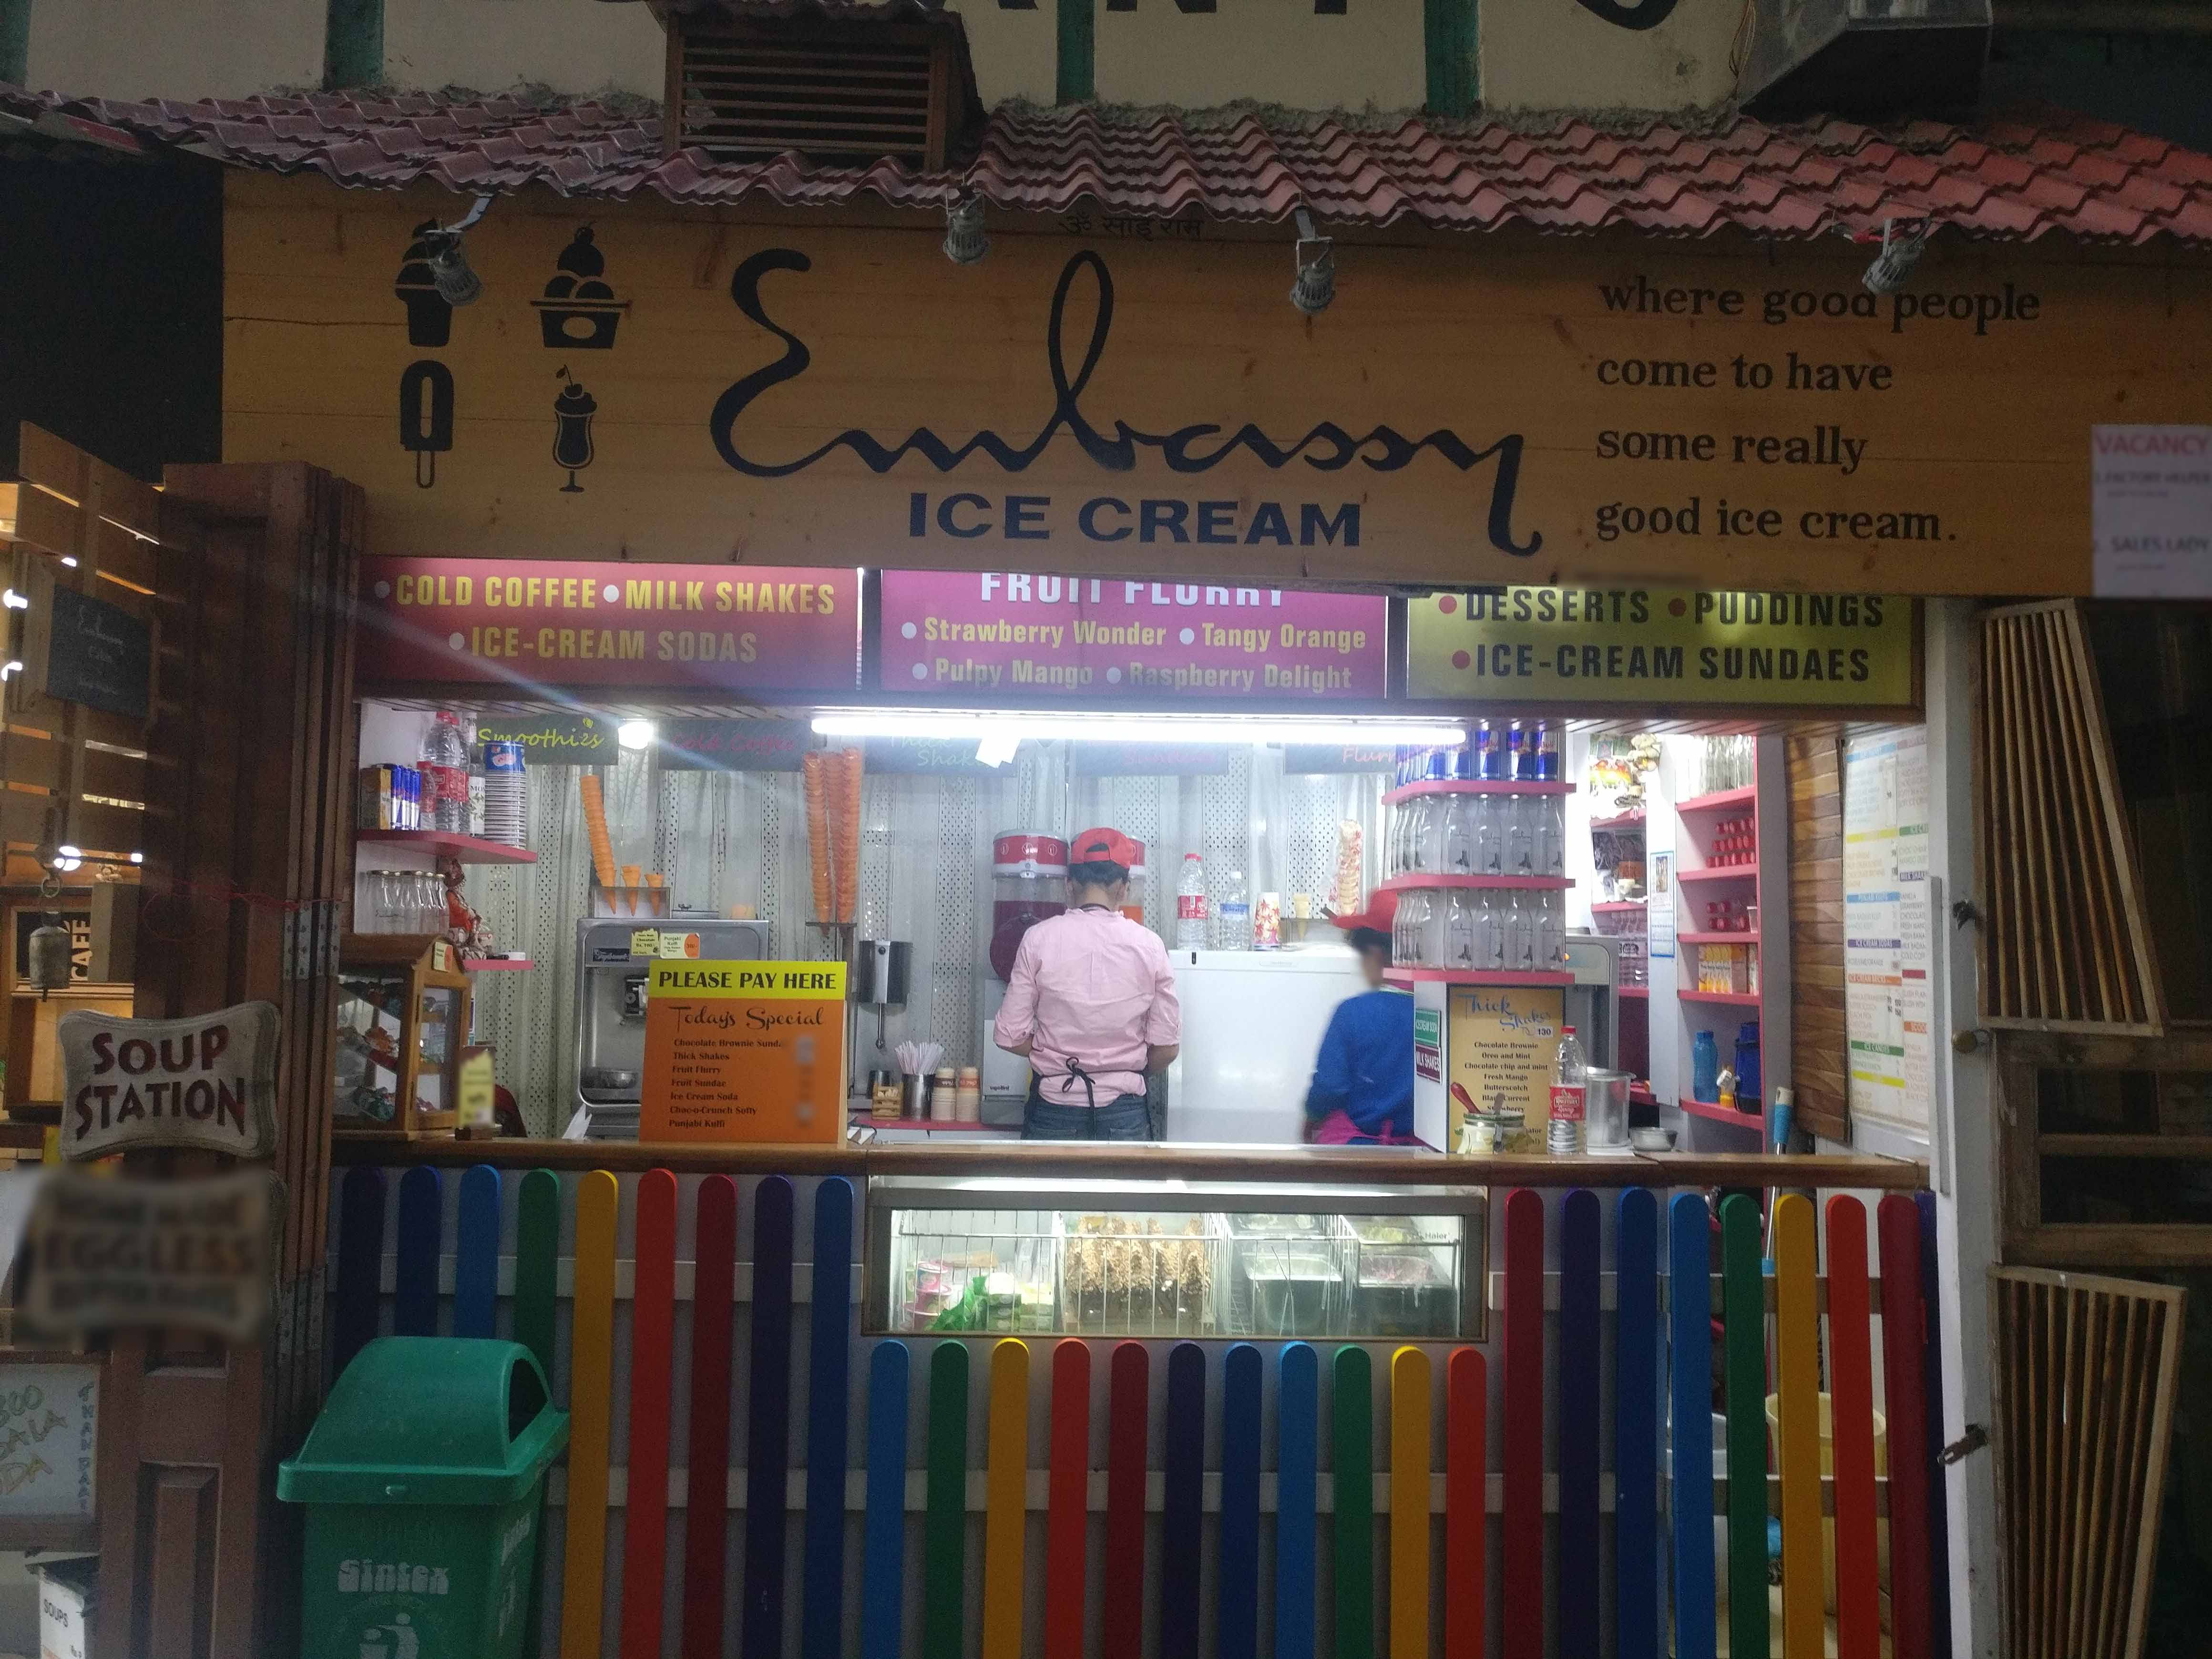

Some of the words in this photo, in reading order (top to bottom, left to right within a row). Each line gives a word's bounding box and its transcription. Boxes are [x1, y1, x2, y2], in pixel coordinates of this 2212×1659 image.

[1599, 276, 1746, 316] where
[1762, 286, 1877, 325] good
[1892, 284, 2041, 336] people
[1597, 358, 1717, 388] come
[1731, 353, 1773, 389] to
[1786, 352, 1893, 391] have
[710, 249, 1543, 556] Embassy
[1597, 429, 1716, 461] some
[1731, 425, 1869, 476] really
[2095, 433, 2210, 455] VACANCY
[909, 492, 1052, 540] ICE
[1077, 496, 1361, 547] CREAM
[1596, 497, 1701, 542] good
[1716, 499, 1782, 537] ice
[1799, 507, 1957, 542] cream.
[397, 574, 473, 606] COLD
[485, 577, 596, 608] COFFEE
[625, 579, 704, 611] MILK
[715, 581, 835, 614] SHAKES
[981, 572, 1101, 603] FRUIT
[1465, 590, 1650, 624] DESSERTS
[1694, 592, 1884, 628] PUDDINGS
[472, 627, 645, 660] ICE-CREAM
[657, 630, 757, 663] SODAS
[923, 616, 1064, 649] Strawberry
[1073, 619, 1167, 647] Wonder
[1201, 622, 1270, 653] Tangy
[1280, 624, 1367, 655] Orange
[934, 658, 1003, 687] Pulpy
[1012, 660, 1093, 689] Mango
[1128, 661, 1254, 692] Raspberry
[1263, 664, 1352, 694] Delight
[1476, 643, 1683, 680] ICE-CREAM
[1699, 646, 1870, 683] SUNDAES
[659, 971, 732, 988] PLEASE
[739, 972, 777, 989] PAY
[783, 973, 836, 990] HERE
[746, 1006, 824, 1031] Special
[1456, 993, 1514, 1021] Thick
[674, 1038, 716, 1047] Chocolate
[718, 1039, 754, 1047] Brownie
[1474, 1041, 1508, 1049] Chocolate
[1537, 1028, 1551, 1036] 130
[92, 1024, 230, 1076] SOUP
[673, 1052, 696, 1060] Thick
[699, 1052, 730, 1061] Shakes
[1416, 1051, 1424, 1068] MILK
[1424, 1053, 1440, 1072] SHAKES
[672, 1065, 694, 1073] Fruit
[696, 1065, 721, 1075] Flurry
[1500, 1063, 1516, 1071] chip
[1505, 1074, 1529, 1082] Mango
[670, 1092, 684, 1100] Ice
[686, 1092, 715, 1101] Cream
[717, 1092, 738, 1101] Soda
[671, 1079, 692, 1087] Fruit
[694, 1079, 727, 1087] Sundae
[1484, 1084, 1528, 1092] Butterscotch
[74, 1077, 246, 1142] STATION
[668, 1119, 703, 1129] Punjabi
[705, 1119, 725, 1128] Kulfi
[338, 1558, 450, 1595] Sintex
